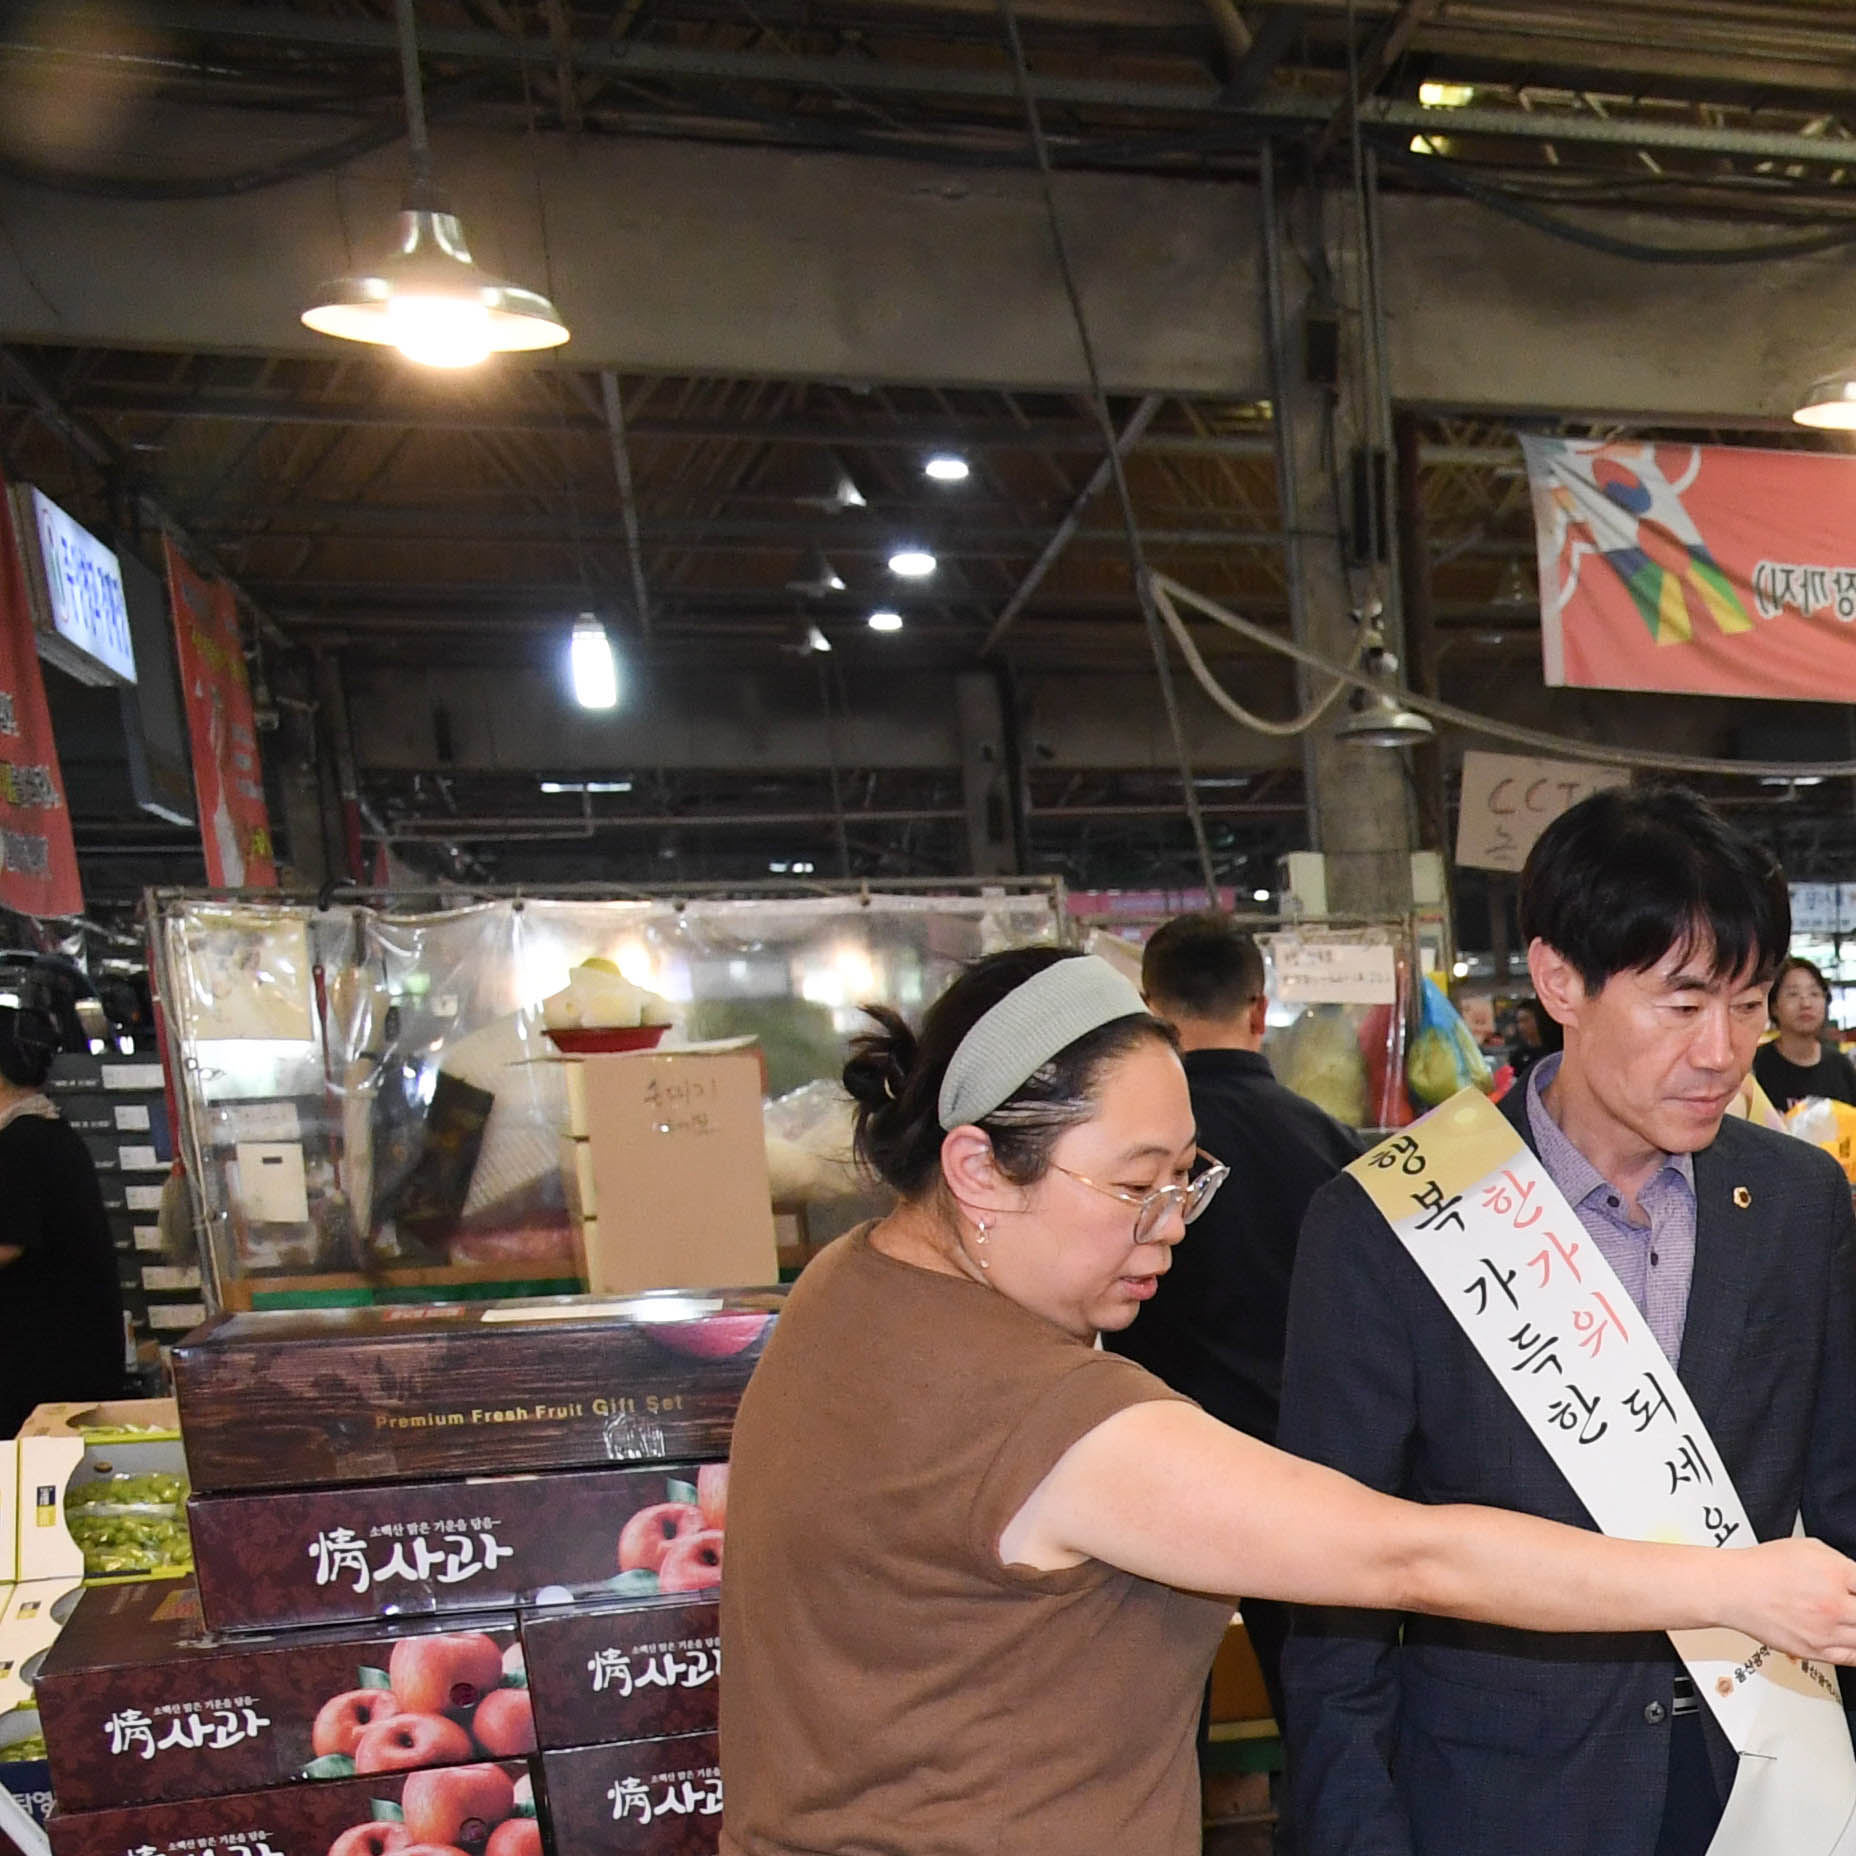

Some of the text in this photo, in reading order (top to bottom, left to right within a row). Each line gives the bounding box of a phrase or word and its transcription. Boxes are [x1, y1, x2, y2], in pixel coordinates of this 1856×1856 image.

[1488, 776, 1602, 817] CCT
[1368, 1134, 1611, 1447] 행복 가득한
[1480, 1168, 1741, 1549] 한가위 되세요
[375, 1394, 684, 1430] Premium Fresh Fruit Gift Set
